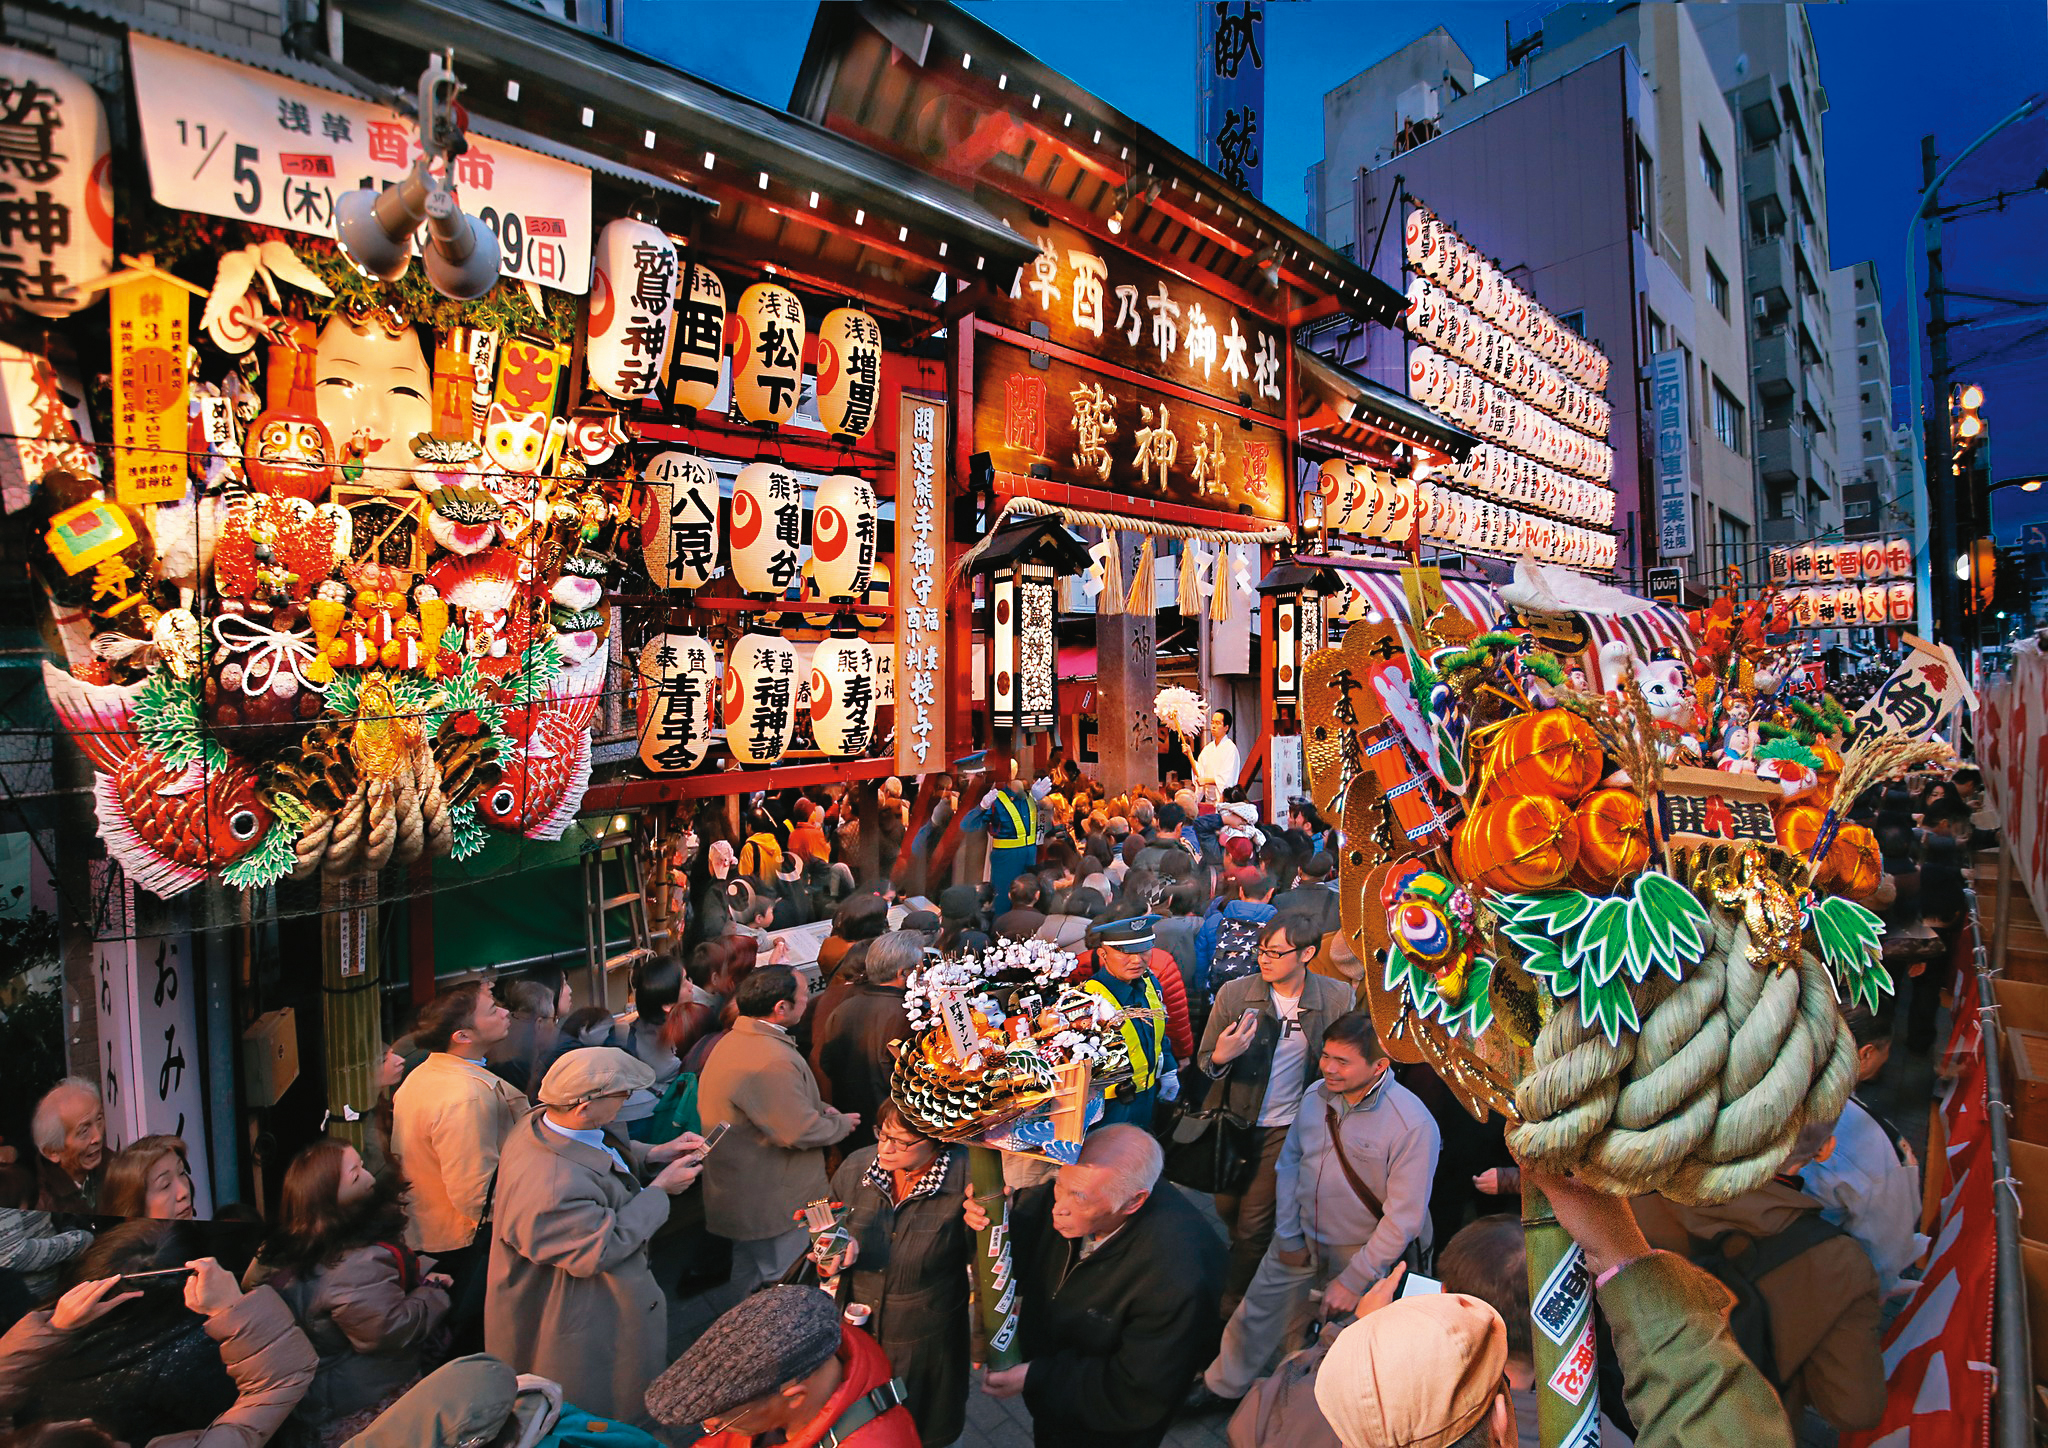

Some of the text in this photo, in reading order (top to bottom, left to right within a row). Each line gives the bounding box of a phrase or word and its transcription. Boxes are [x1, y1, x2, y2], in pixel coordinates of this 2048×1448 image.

[278, 97, 495, 192] 浅草 酉市
[284, 177, 333, 228] (木)
[527, 237, 566, 283] (日)
[613, 241, 676, 396] 鷲神社
[758, 292, 801, 324] 浅草
[845, 316, 880, 347] 浅草
[1011, 236, 1282, 400] 草酉乃市御本社
[756, 320, 800, 415] 松下
[839, 346, 877, 437] 増田屋
[1068, 382, 1231, 498] 鷲神社
[1658, 358, 1685, 523] 三和自動車工業
[766, 503, 800, 587] 亀谷
[912, 406, 936, 607] 開運熊手御守
[1772, 548, 1905, 578] 鷲神社酉の市
[656, 646, 707, 675] 奉賛
[754, 648, 793, 675] 浅草
[838, 648, 873, 673] 熊手
[653, 673, 700, 770] 青年会
[749, 677, 790, 760] 福神講
[910, 670, 936, 765] 授与す
